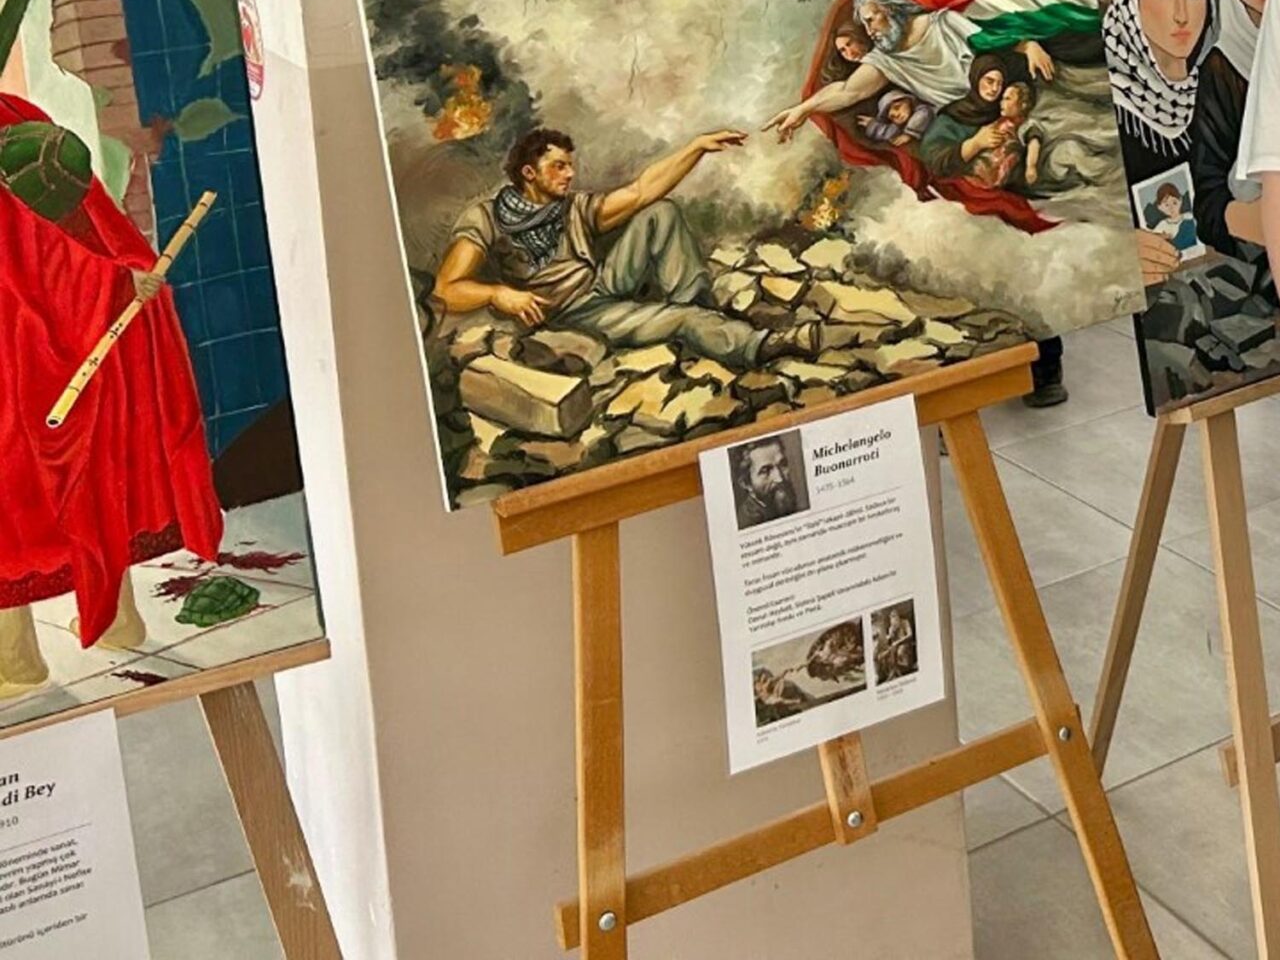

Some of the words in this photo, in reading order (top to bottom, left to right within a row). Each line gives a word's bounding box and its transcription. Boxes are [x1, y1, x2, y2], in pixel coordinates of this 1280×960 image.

[812, 428, 892, 460] Michelangelo
[815, 447, 880, 477] Buonarroti
[2, 789, 19, 806] di
[25, 783, 56, 800] Bey
